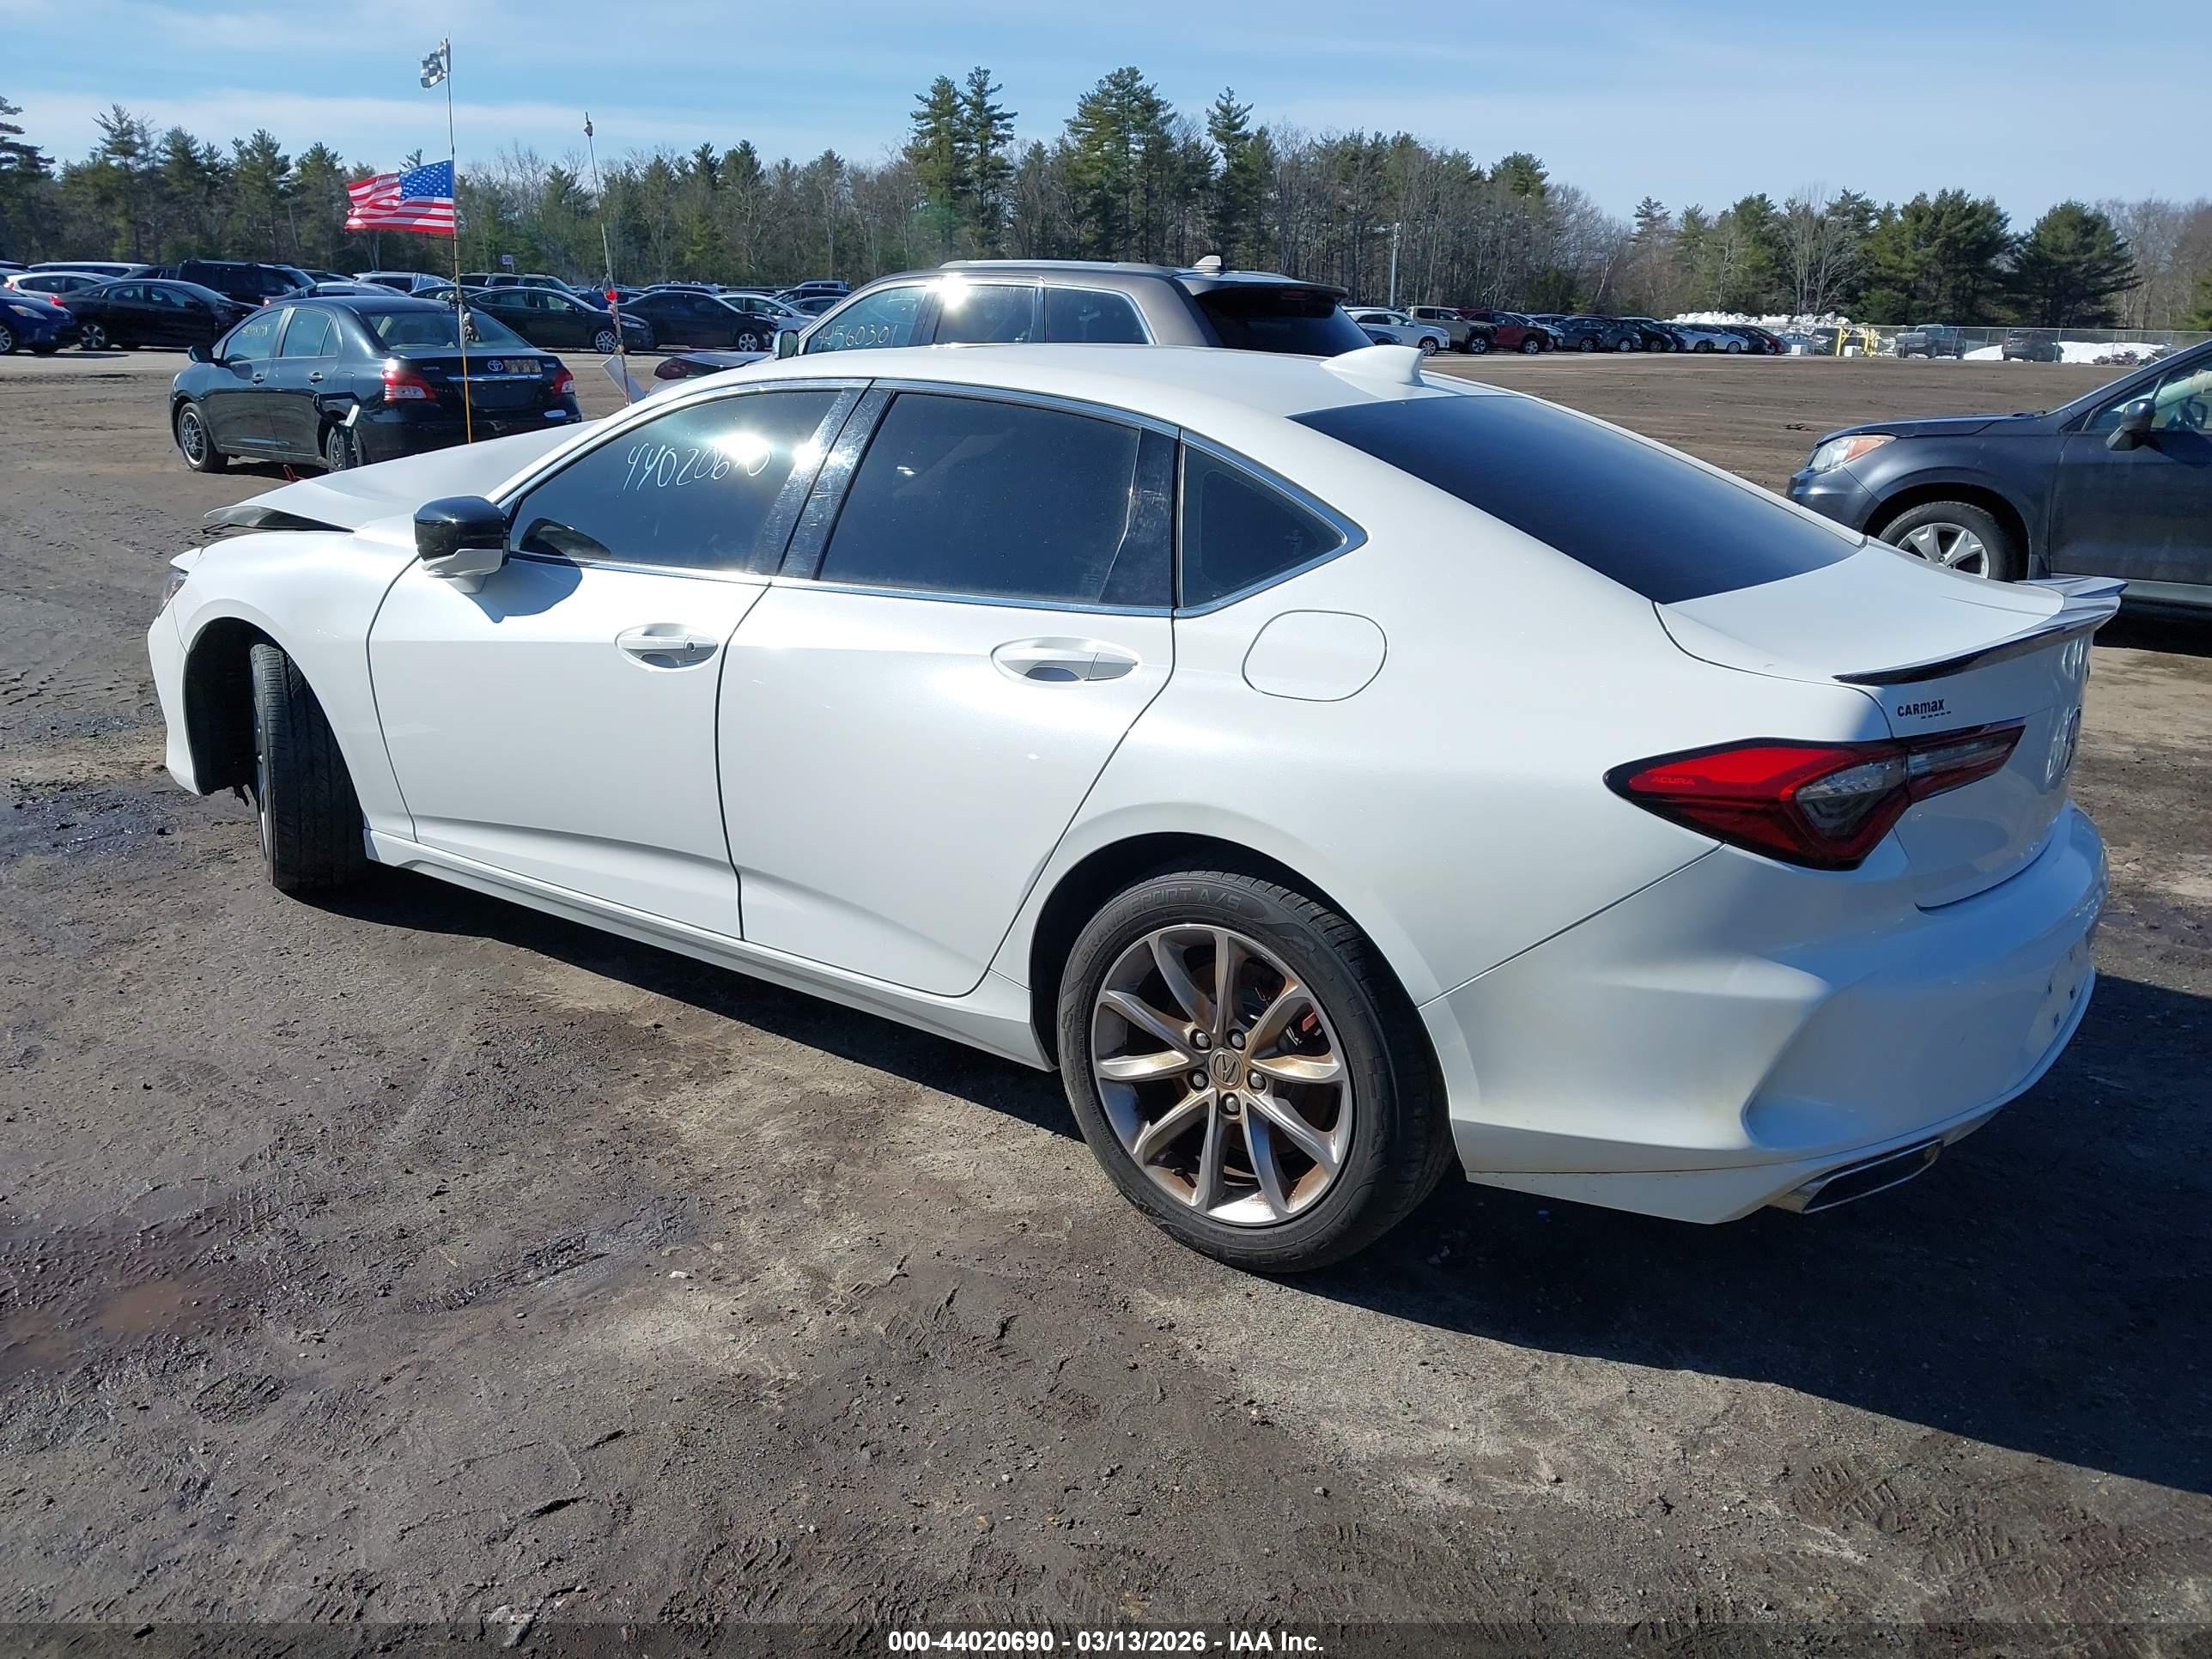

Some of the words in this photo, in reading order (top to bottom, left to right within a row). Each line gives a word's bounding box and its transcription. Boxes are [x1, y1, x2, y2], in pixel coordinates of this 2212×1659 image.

[818, 324, 898, 350] 44560301
[1651, 775, 1695, 786] ACURA
[1130, 887, 1192, 914] SPORT
